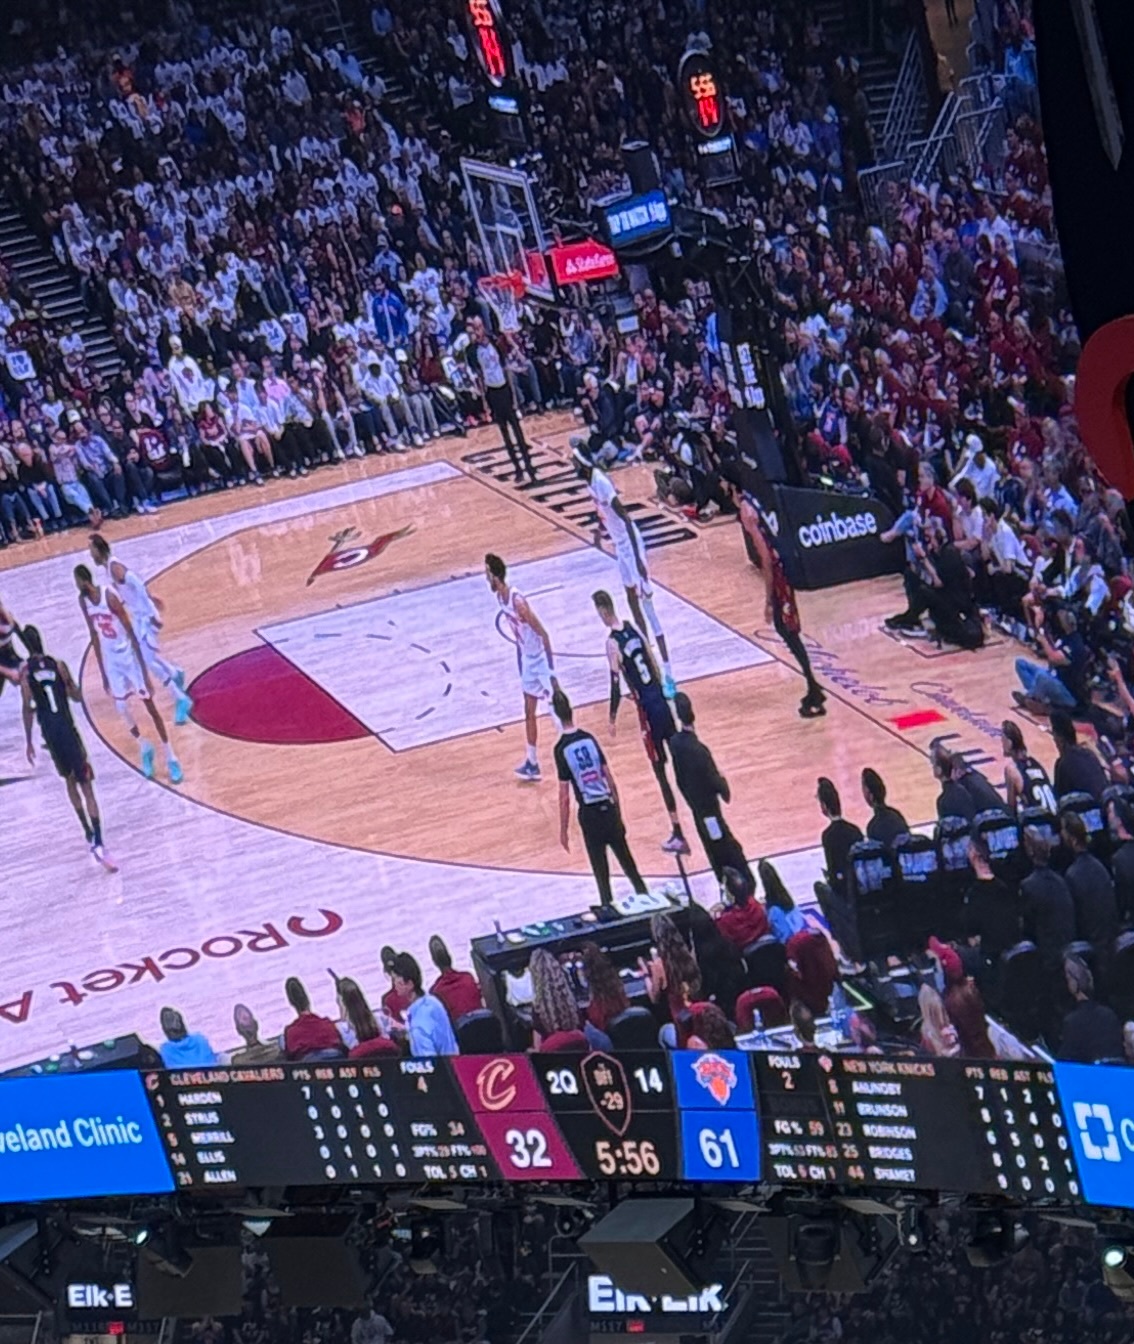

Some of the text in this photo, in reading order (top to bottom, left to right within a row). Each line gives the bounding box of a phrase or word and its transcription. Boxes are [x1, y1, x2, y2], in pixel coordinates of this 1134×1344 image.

[799, 511, 877, 548] coinbase
[51, 921, 290, 1006] Rocket
[546, 1070, 578, 1095] 2Q
[634, 1067, 663, 1093] 14
[0, 1117, 142, 1153] eland Clinic
[505, 1128, 552, 1168] 32
[699, 1129, 740, 1168] 61
[596, 1140, 660, 1176] 5:56
